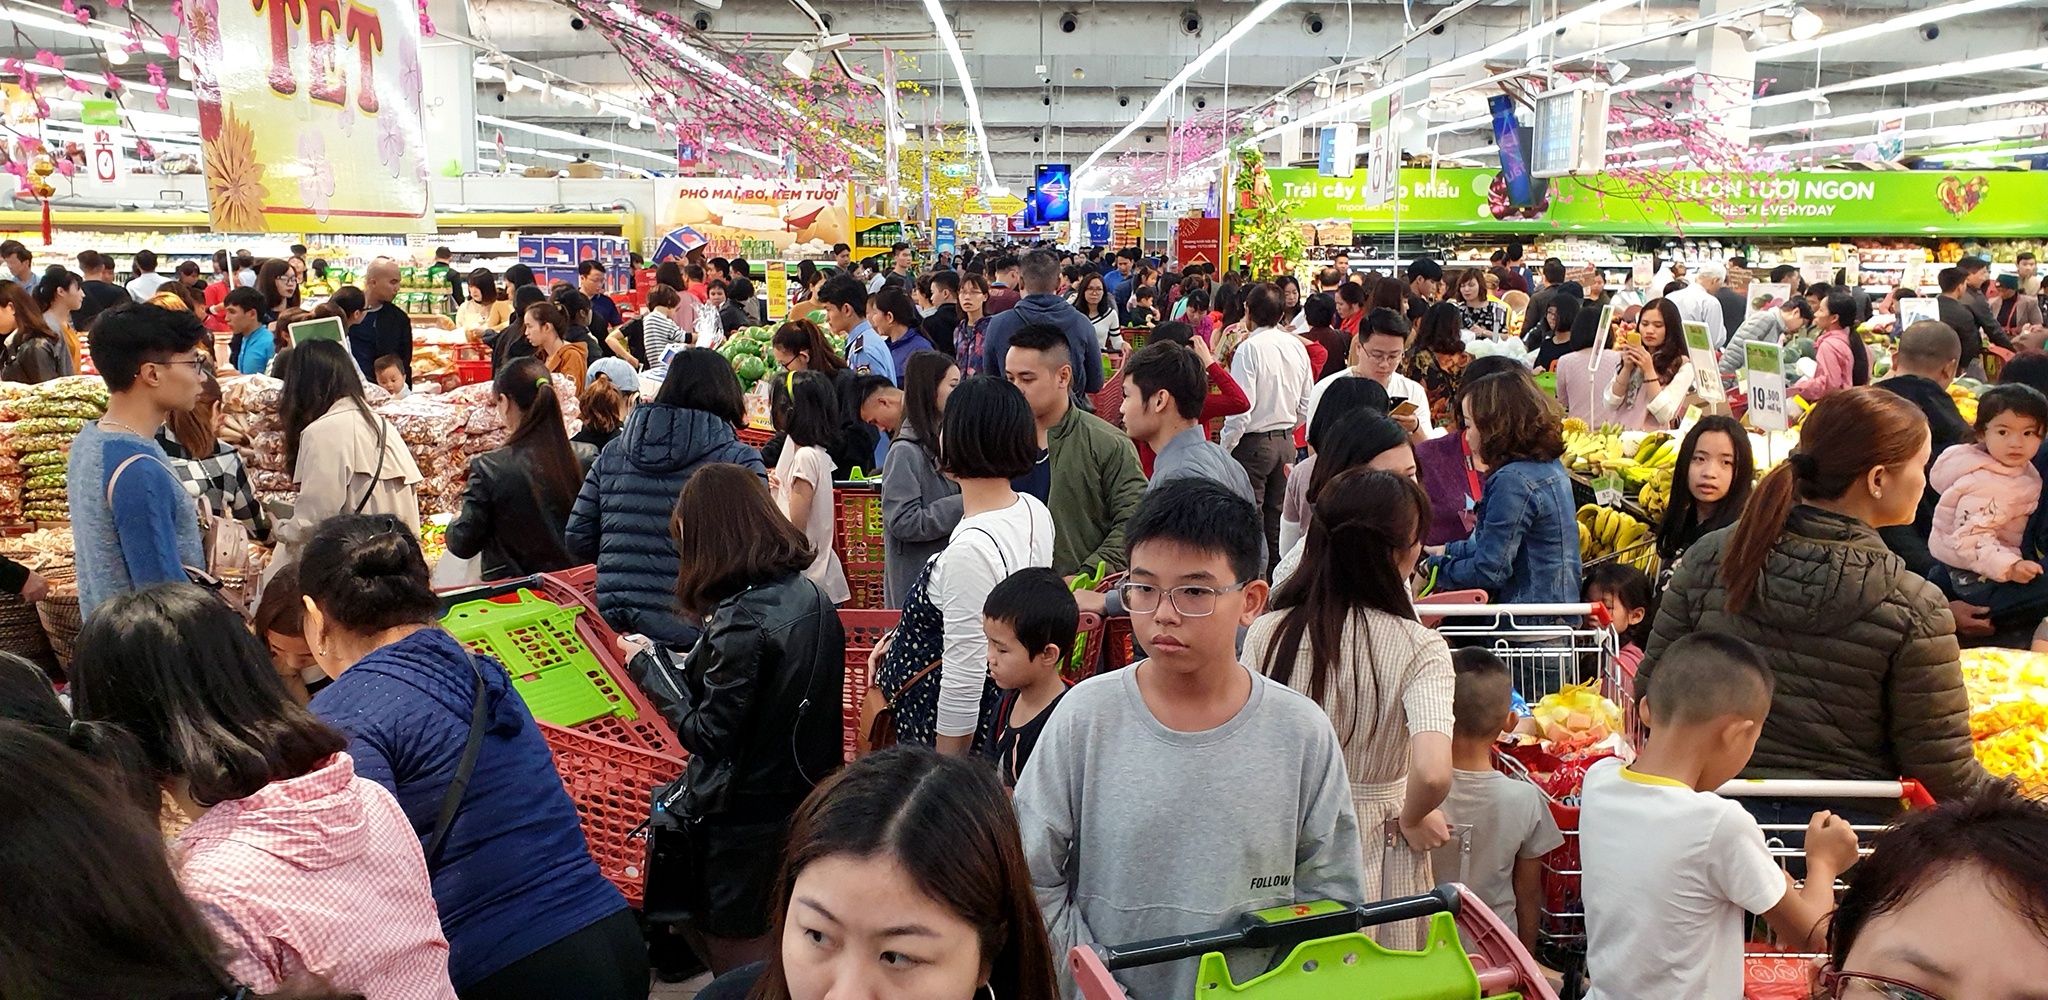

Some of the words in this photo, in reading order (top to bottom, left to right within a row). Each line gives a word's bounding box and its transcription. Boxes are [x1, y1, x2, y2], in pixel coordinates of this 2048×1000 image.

[679, 187, 709, 199] PHÔ
[712, 189, 742, 201] MAI,
[746, 188, 768, 201] BƠ,
[772, 190, 801, 200] KEM
[1283, 182, 1317, 199] Trái
[1323, 182, 1356, 201] cây
[1414, 180, 1460, 199] khẩu
[1805, 180, 1875, 201] NGON
[1336, 204, 1381, 213] Imported
[1760, 204, 1836, 217] EVERYDAY
[1753, 386, 1765, 410] 19
[1250, 875, 1292, 890] FOLLOW
